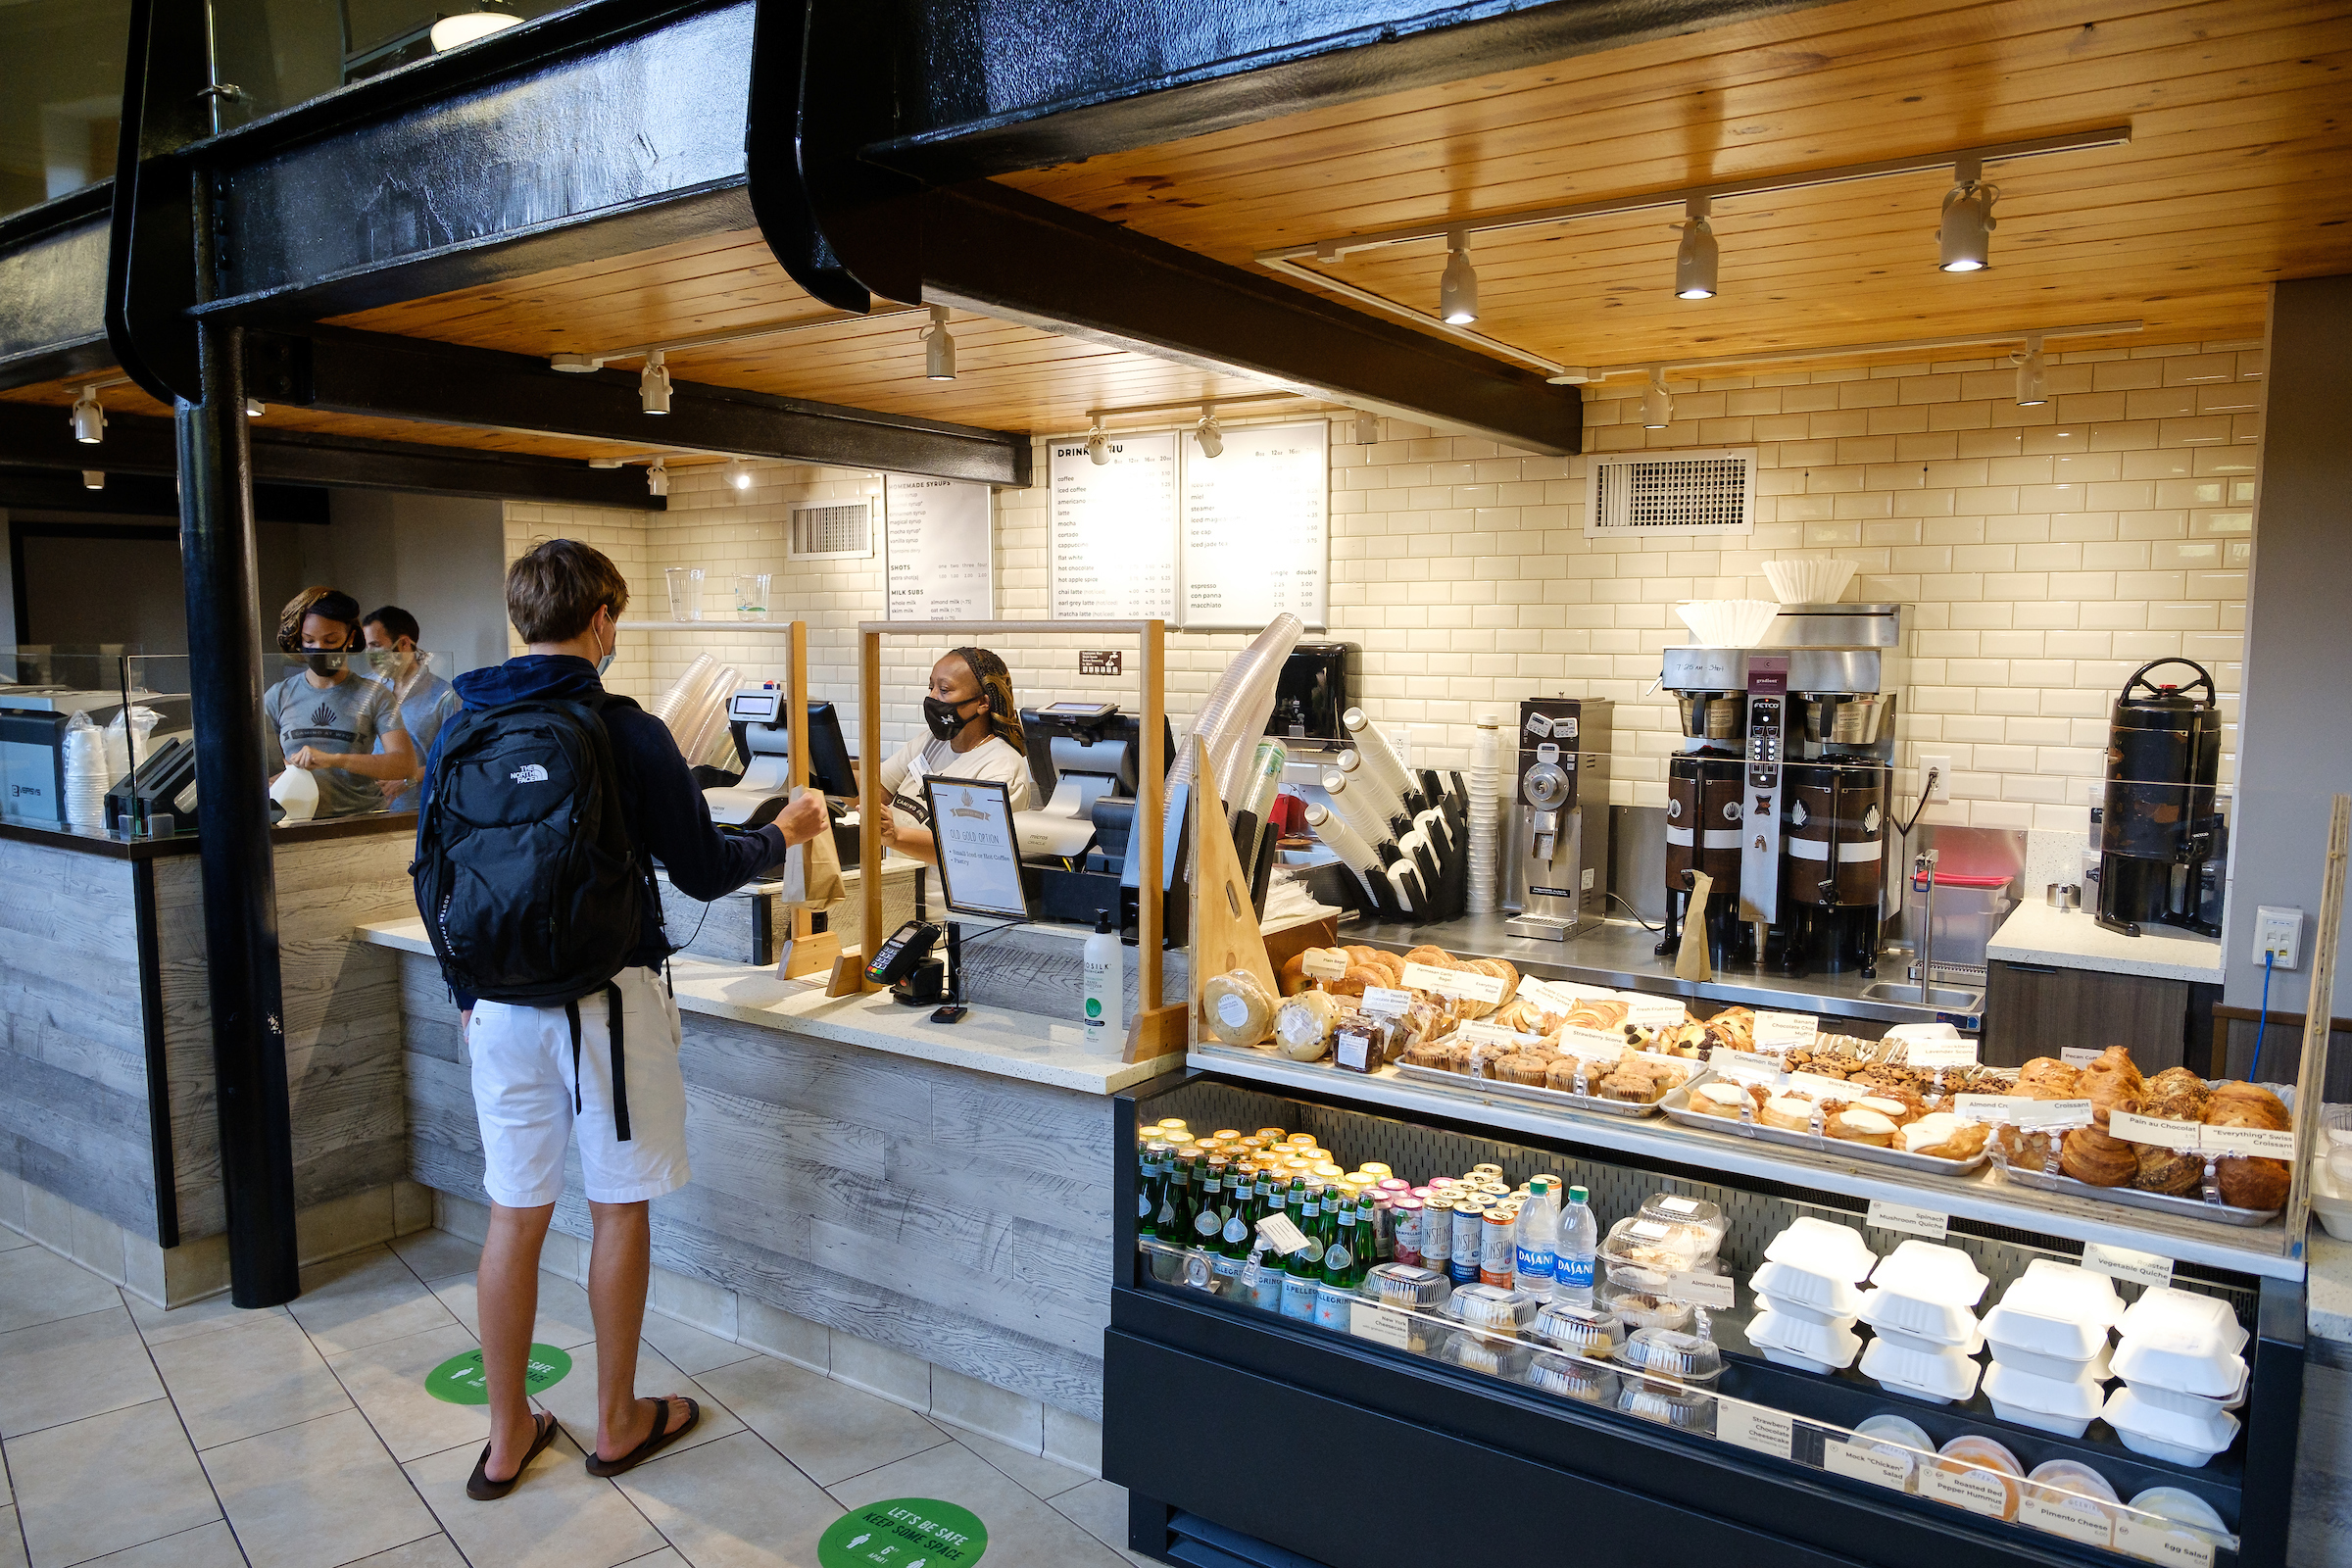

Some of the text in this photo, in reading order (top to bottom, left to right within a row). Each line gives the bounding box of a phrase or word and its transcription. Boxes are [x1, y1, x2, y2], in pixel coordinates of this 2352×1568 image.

[1058, 448, 1090, 457] DRINK
[897, 799, 917, 811] CAMINO
[950, 829, 1000, 844] OLD GOLD OPTION
[954, 858, 969, 866] Pastry
[1472, 1022, 1496, 1031] Blueberry
[1573, 1031, 1622, 1044] Strawberry Scone
[1735, 1054, 1766, 1065] Cinnamon
[1828, 1080, 1848, 1090] Sticky
[2160, 1123, 2196, 1132] Chocolat
[1880, 1213, 1943, 1231] Mushroom Quiche
[1916, 1213, 1944, 1223] Spinach
[1422, 1224, 1450, 1246] UNSHIN
[1518, 1250, 1552, 1265] DASANI
[1557, 1259, 1593, 1275] DASANI
[2097, 1258, 2168, 1280] Vegetable Quiche
[2136, 1259, 2170, 1272] Roasted
[1375, 1320, 1406, 1332] Cheesecake
[530, 1362, 555, 1373] SAFE
[1752, 1416, 1790, 1431] Strawberry
[1748, 1430, 1789, 1445] Cheesecake
[1755, 1424, 1789, 1438] Chocolate
[1845, 1451, 1866, 1462] Mock
[1883, 1469, 1903, 1480] Salad
[1936, 1483, 2002, 1505] Pepper Hummus
[1954, 1480, 2002, 1497] Roasted Red
[887, 1507, 968, 1546] LET'S BE SAFE
[2040, 1508, 2108, 1532] Pimento Cheese
[862, 1512, 964, 1561] KEEP SOME SPACE
[2164, 1543, 2208, 1560] Egg Salad
[867, 1552, 889, 1565] APART
